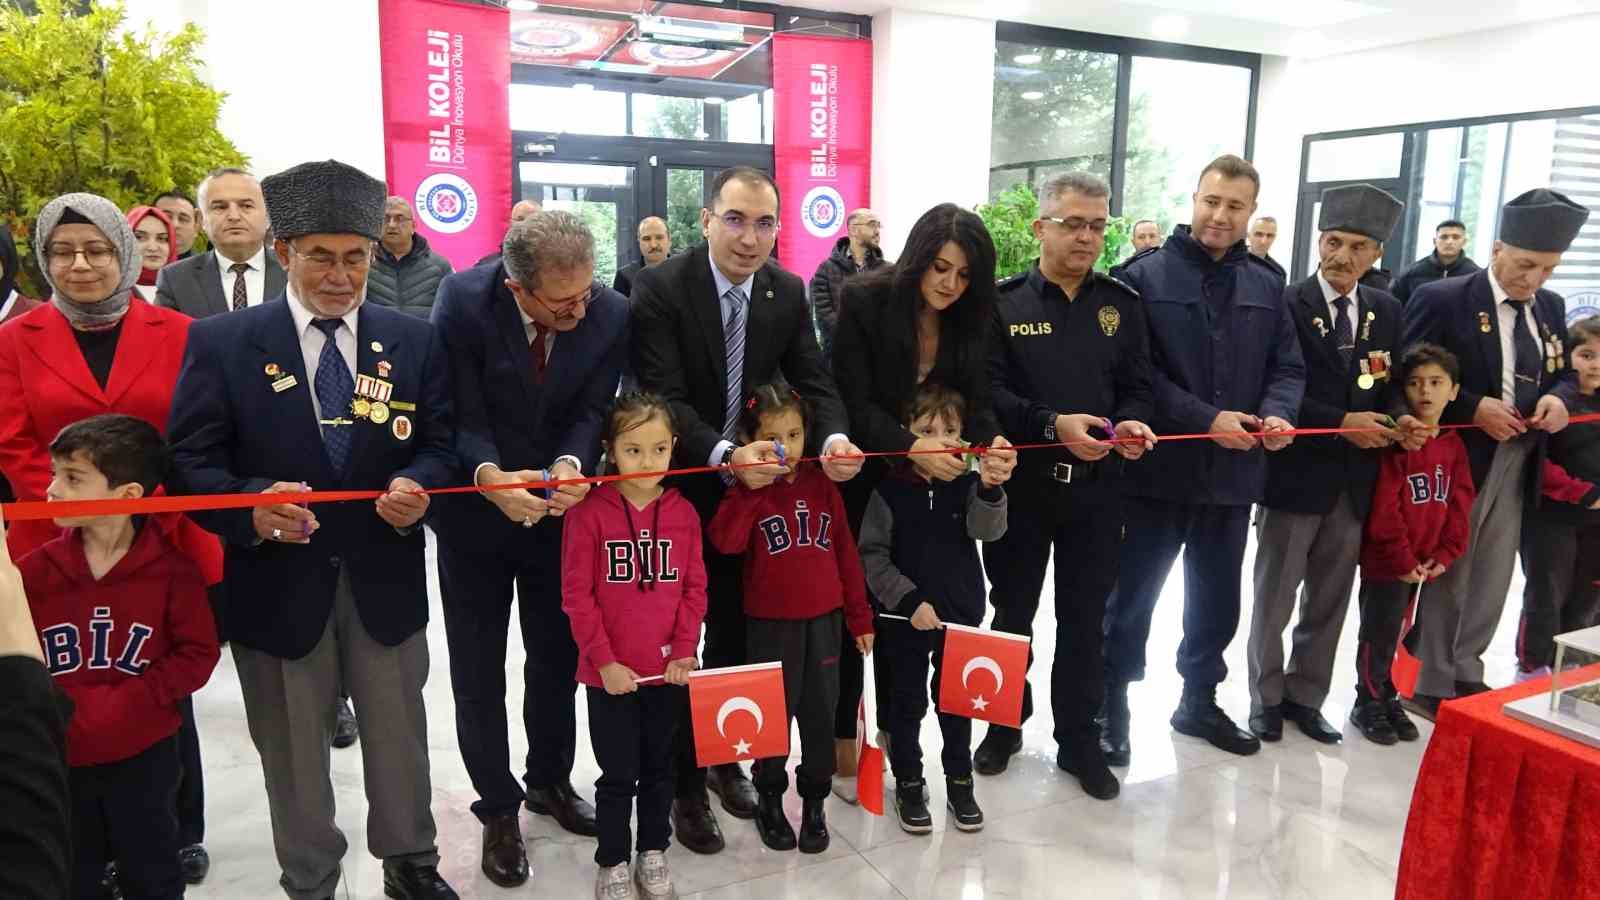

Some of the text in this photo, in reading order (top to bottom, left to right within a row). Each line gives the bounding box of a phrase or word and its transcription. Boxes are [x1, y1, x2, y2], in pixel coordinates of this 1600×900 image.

[451, 34, 466, 165] Dünya İnovasyon Okulu
[828, 64, 838, 94] Okulu
[1407, 464, 1451, 508] Bİ
[759, 500, 833, 555] BİL
[605, 529, 679, 583] BİL
[41, 606, 154, 676] BİL
